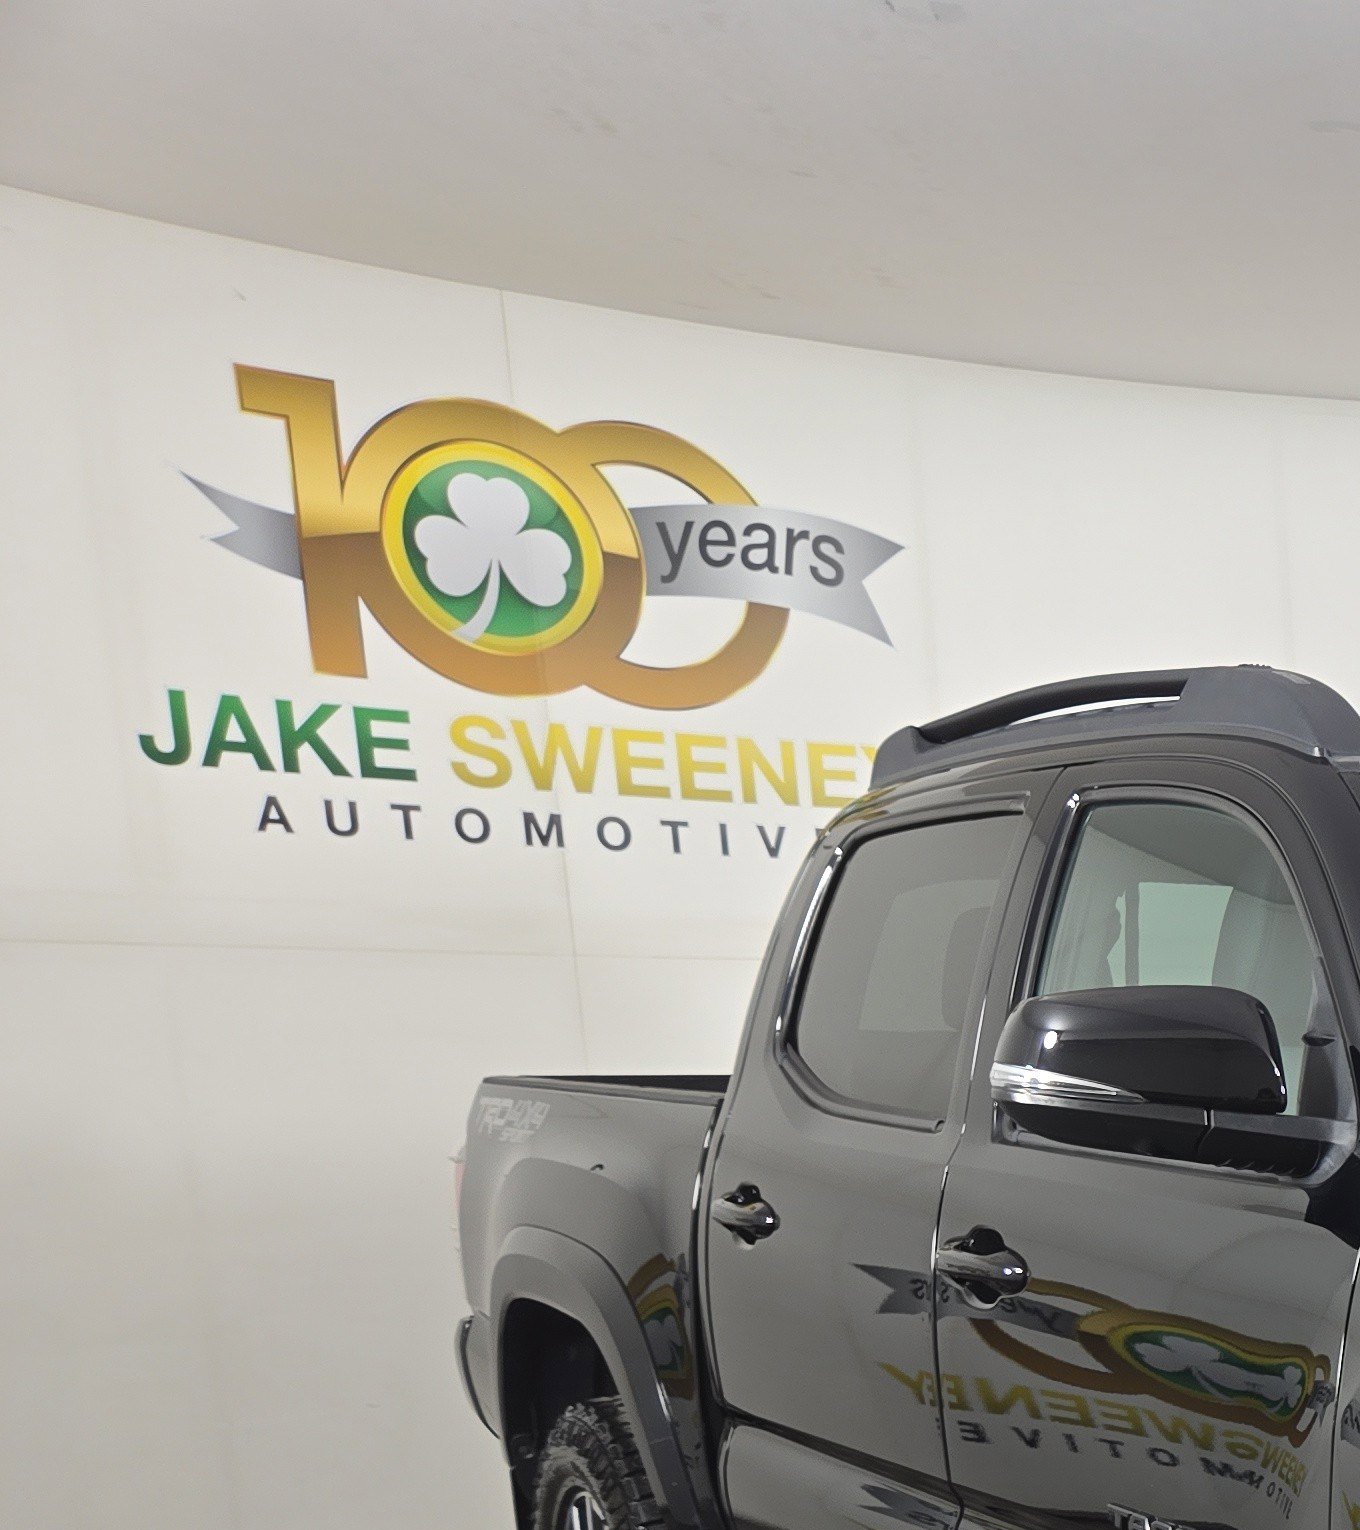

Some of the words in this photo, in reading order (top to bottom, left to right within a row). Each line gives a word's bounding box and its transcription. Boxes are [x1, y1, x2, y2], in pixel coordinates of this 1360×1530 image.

[233, 362, 790, 710] 100
[654, 518, 846, 588] years
[138, 689, 418, 782] JAKE
[449, 715, 878, 809] SWEENE
[257, 795, 828, 860] AUTOMOTIV
